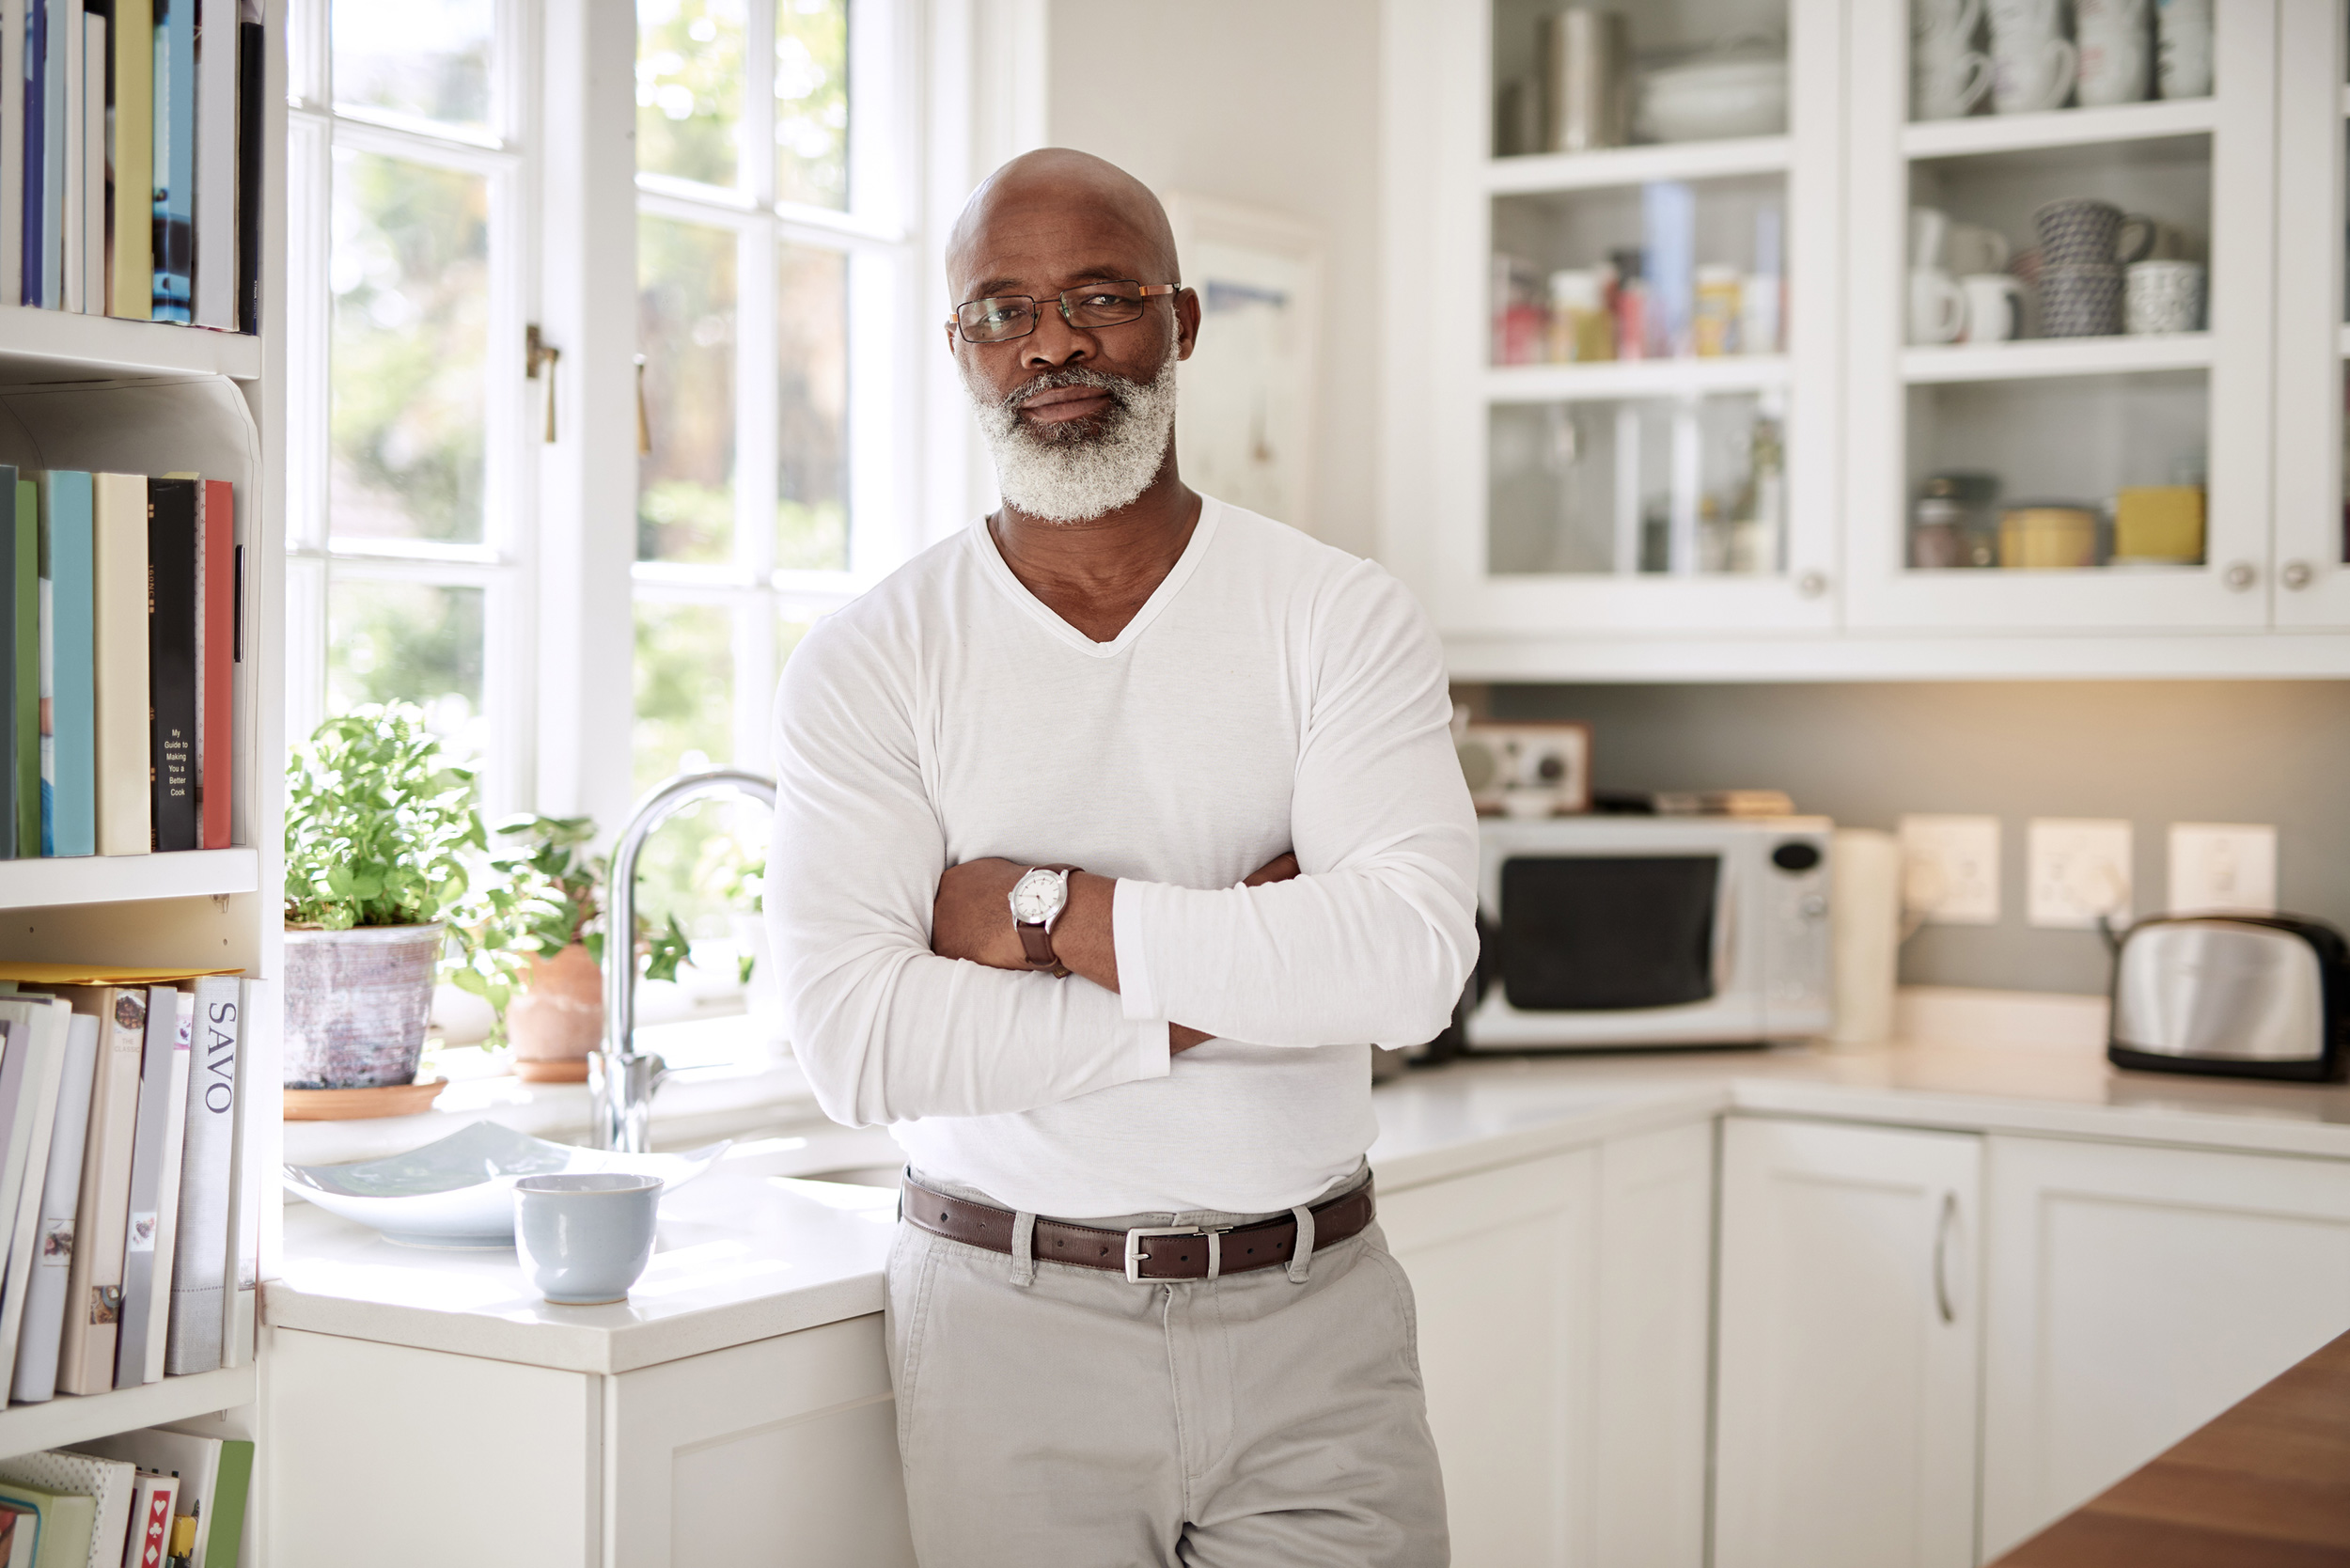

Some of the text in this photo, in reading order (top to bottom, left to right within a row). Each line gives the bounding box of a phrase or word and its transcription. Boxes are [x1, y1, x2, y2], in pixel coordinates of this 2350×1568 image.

[171, 729, 180, 738] My
[166, 753, 187, 761] Making
[170, 788, 185, 796] Cook
[205, 1002, 237, 1114] SAVO
